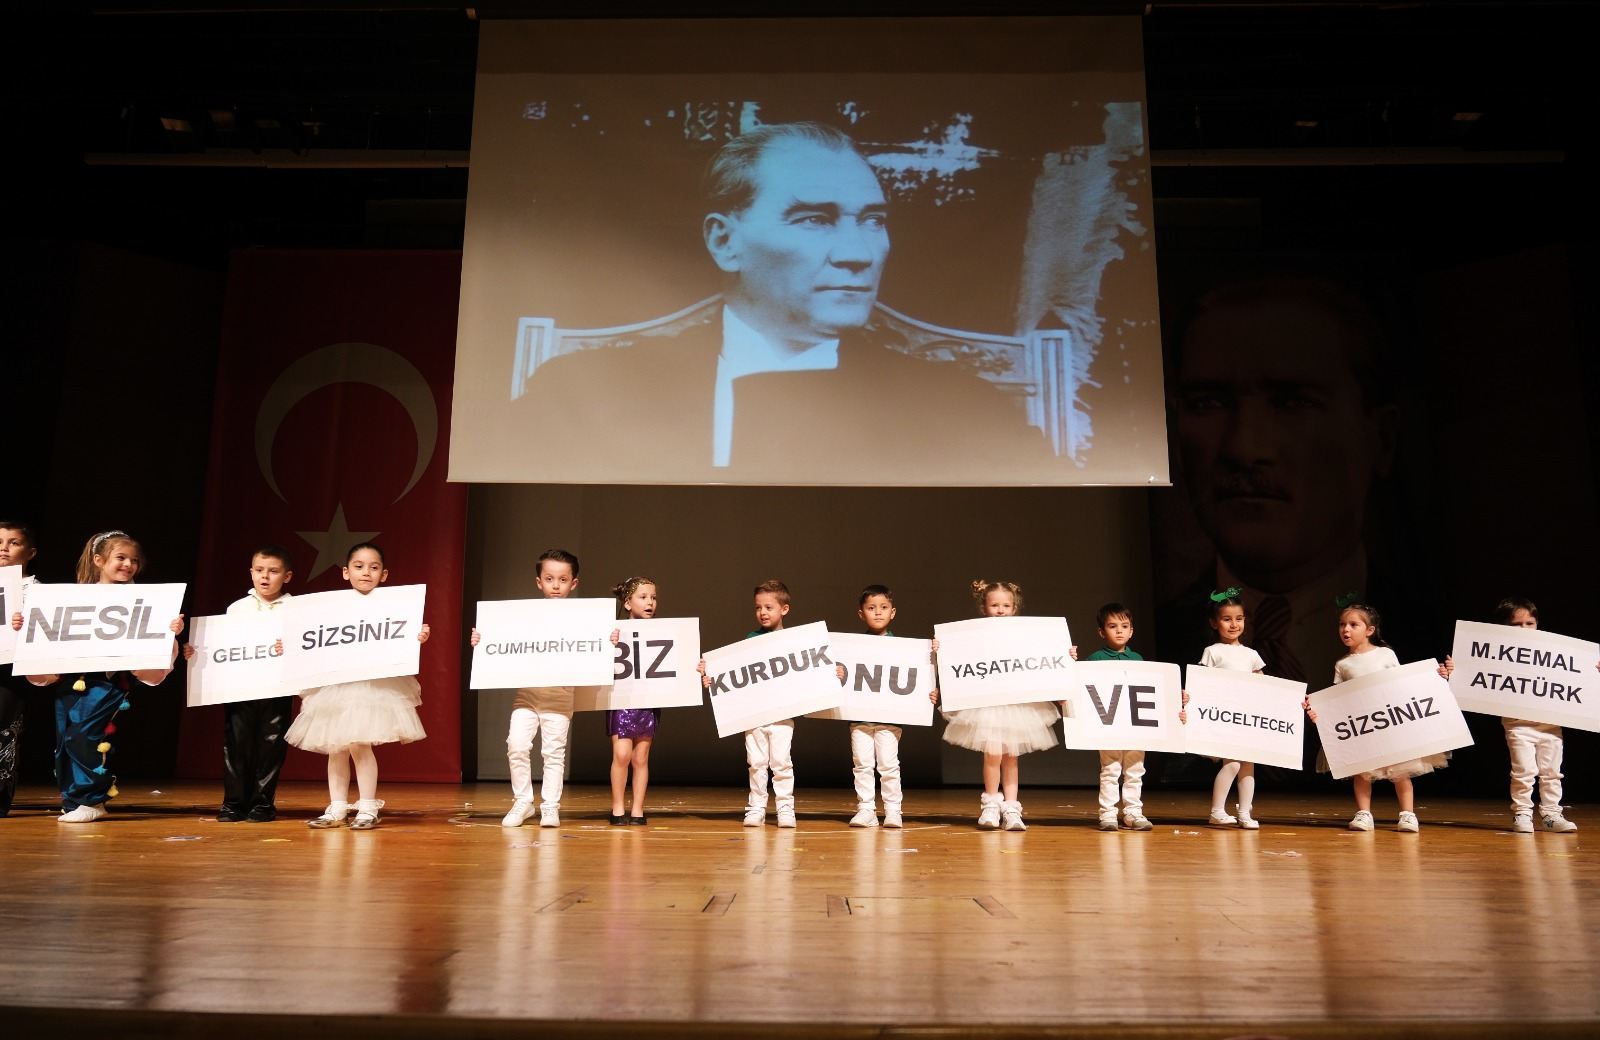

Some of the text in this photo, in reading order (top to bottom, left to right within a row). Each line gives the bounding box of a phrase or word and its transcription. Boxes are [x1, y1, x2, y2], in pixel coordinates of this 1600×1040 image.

[26, 598, 166, 643] NESİL
[301, 617, 408, 651] SİZSİNİZ
[213, 643, 282, 663] GELEC
[485, 638, 602, 656] CUMHURİYETİ
[1470, 641, 1581, 673] M.KEMAL
[710, 645, 833, 697] KURDUK
[951, 655, 1066, 680] YAŞATACAK
[1470, 671, 1582, 704] ATATÜRK
[1085, 684, 1159, 727] VE
[1197, 707, 1295, 735] YÜCELTECEK
[1334, 696, 1440, 741] SİZSİNİZ
